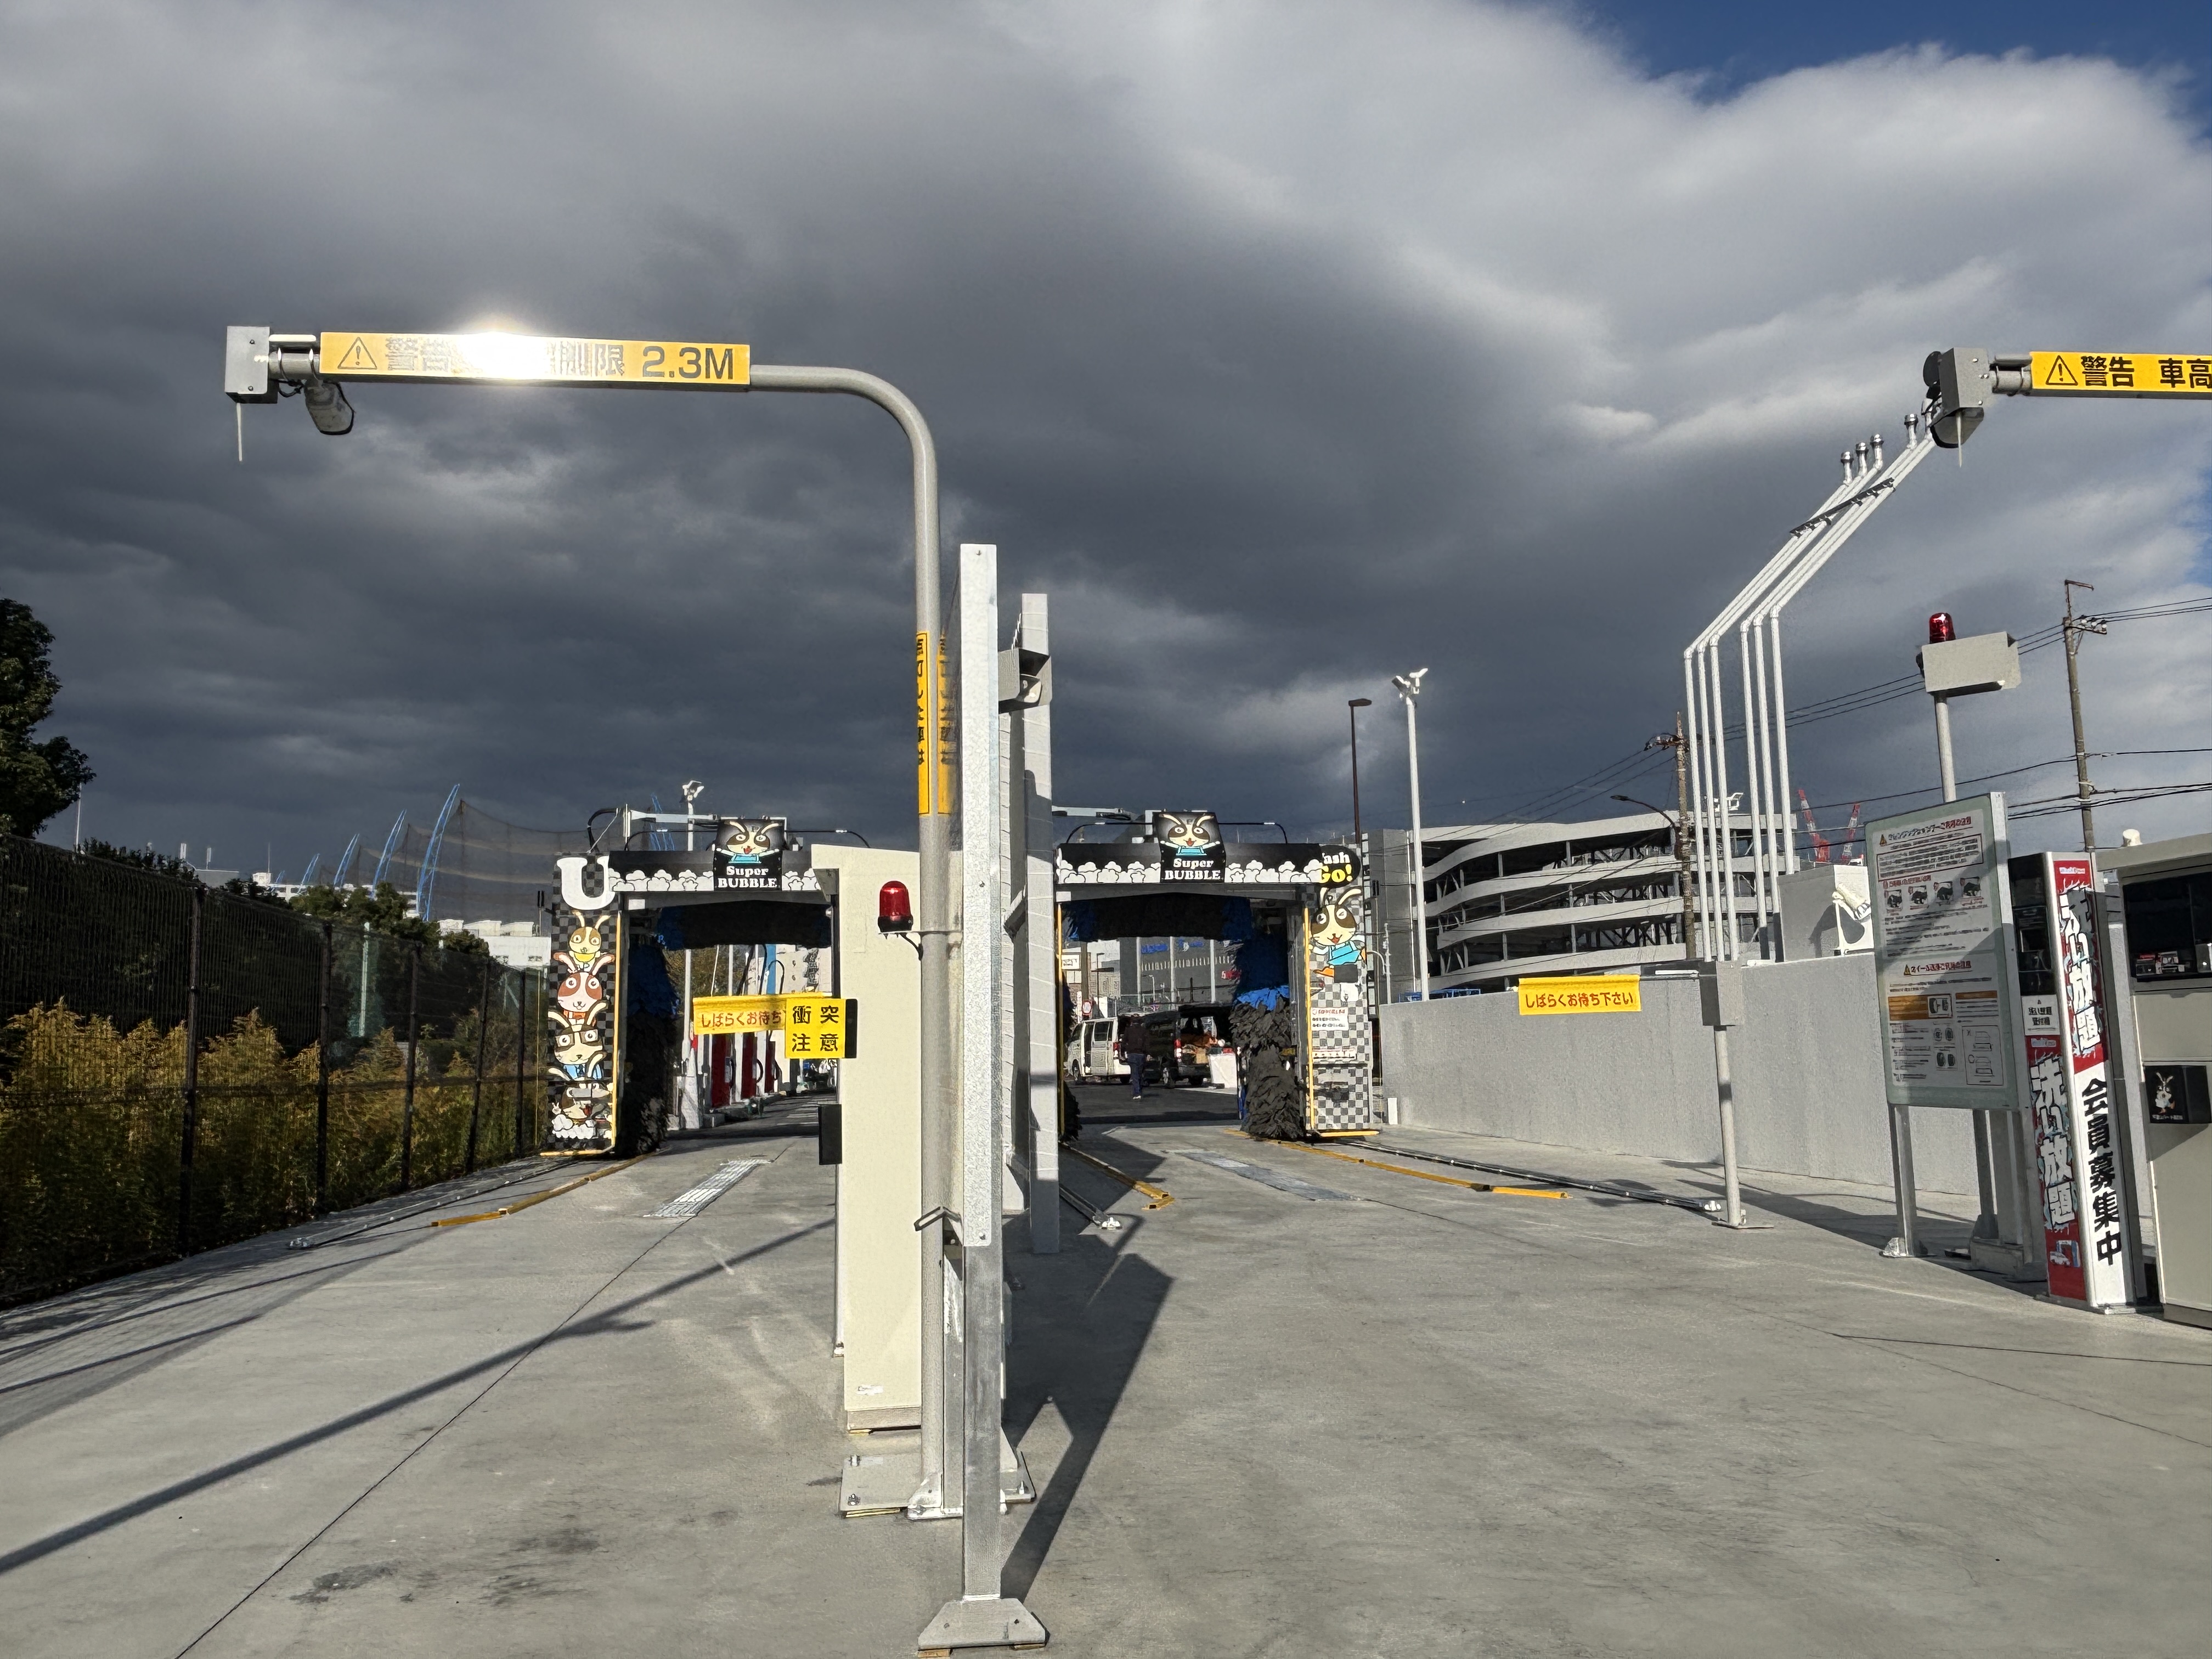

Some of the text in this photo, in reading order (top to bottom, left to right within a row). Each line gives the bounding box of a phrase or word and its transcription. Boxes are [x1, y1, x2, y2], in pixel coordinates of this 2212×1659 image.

[642, 345, 733, 380] 2.3M
[2080, 356, 2212, 389] 警告 車高
[1173, 857, 1214, 870] Super
[1322, 851, 1351, 865] ash
[726, 865, 769, 878] Super
[1164, 870, 1221, 881] BUBBLE
[718, 878, 777, 888] BUBBLE
[1525, 991, 1634, 1008] しばらくお待ち下さい
[701, 1010, 782, 1028] しばらくお待ち
[792, 1005, 839, 1025] 衝突
[791, 1032, 839, 1052] 注意
[2030, 1058, 2075, 1226] 洗い放題
[2082, 1077, 2123, 1265] 会員募集中
